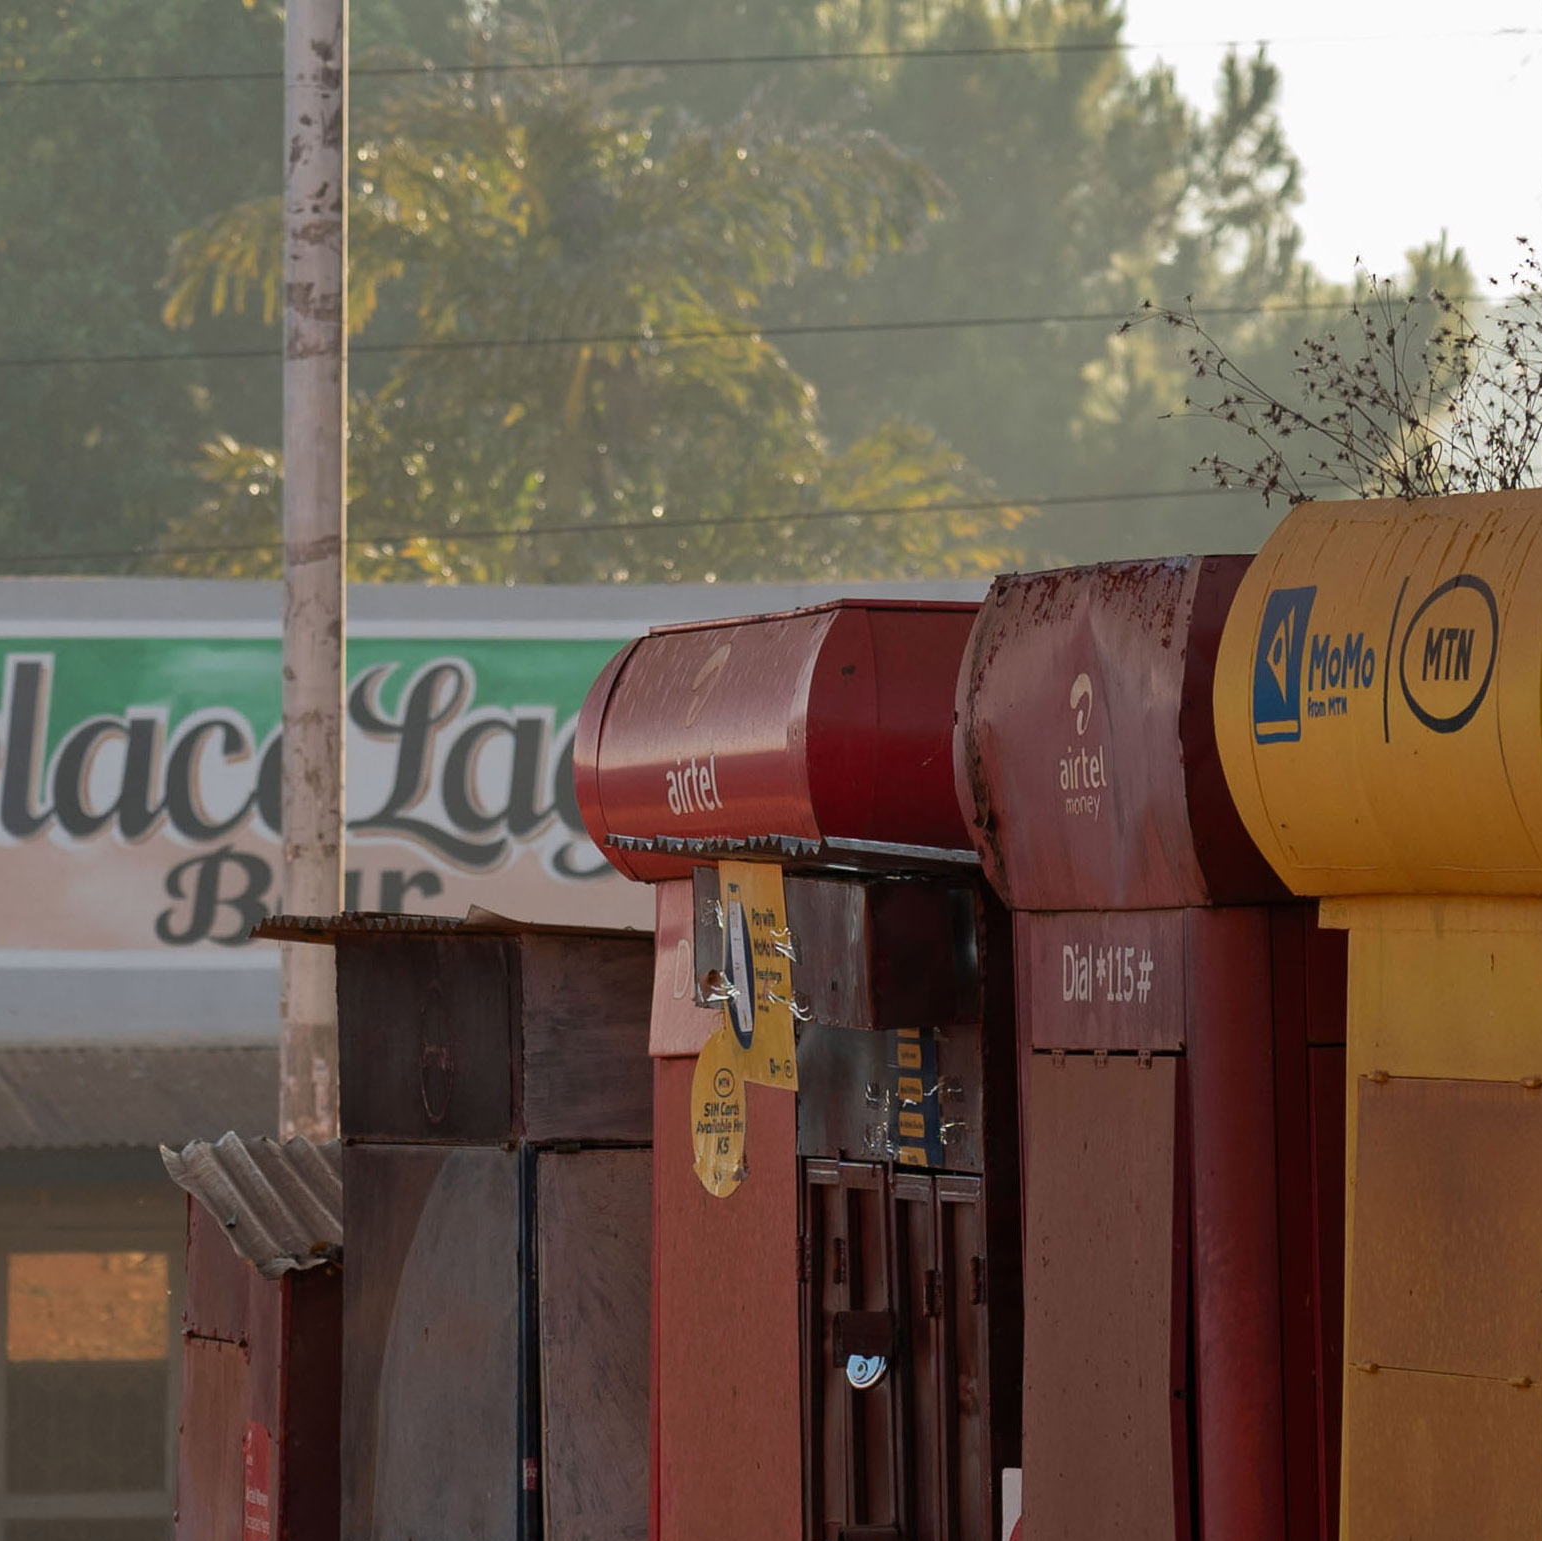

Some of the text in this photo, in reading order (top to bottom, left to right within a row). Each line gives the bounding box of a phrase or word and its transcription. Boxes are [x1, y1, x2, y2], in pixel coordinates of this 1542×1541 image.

[1308, 632, 1375, 692] MoMo
[1422, 627, 1475, 681] MTN
[1308, 696, 1348, 717] from MTN
[666, 753, 724, 817] airtel
[1059, 744, 1107, 791] airtel
[1065, 793, 1102, 822] money
[156, 845, 444, 946] Br
[1062, 943, 1093, 1003] Dial
